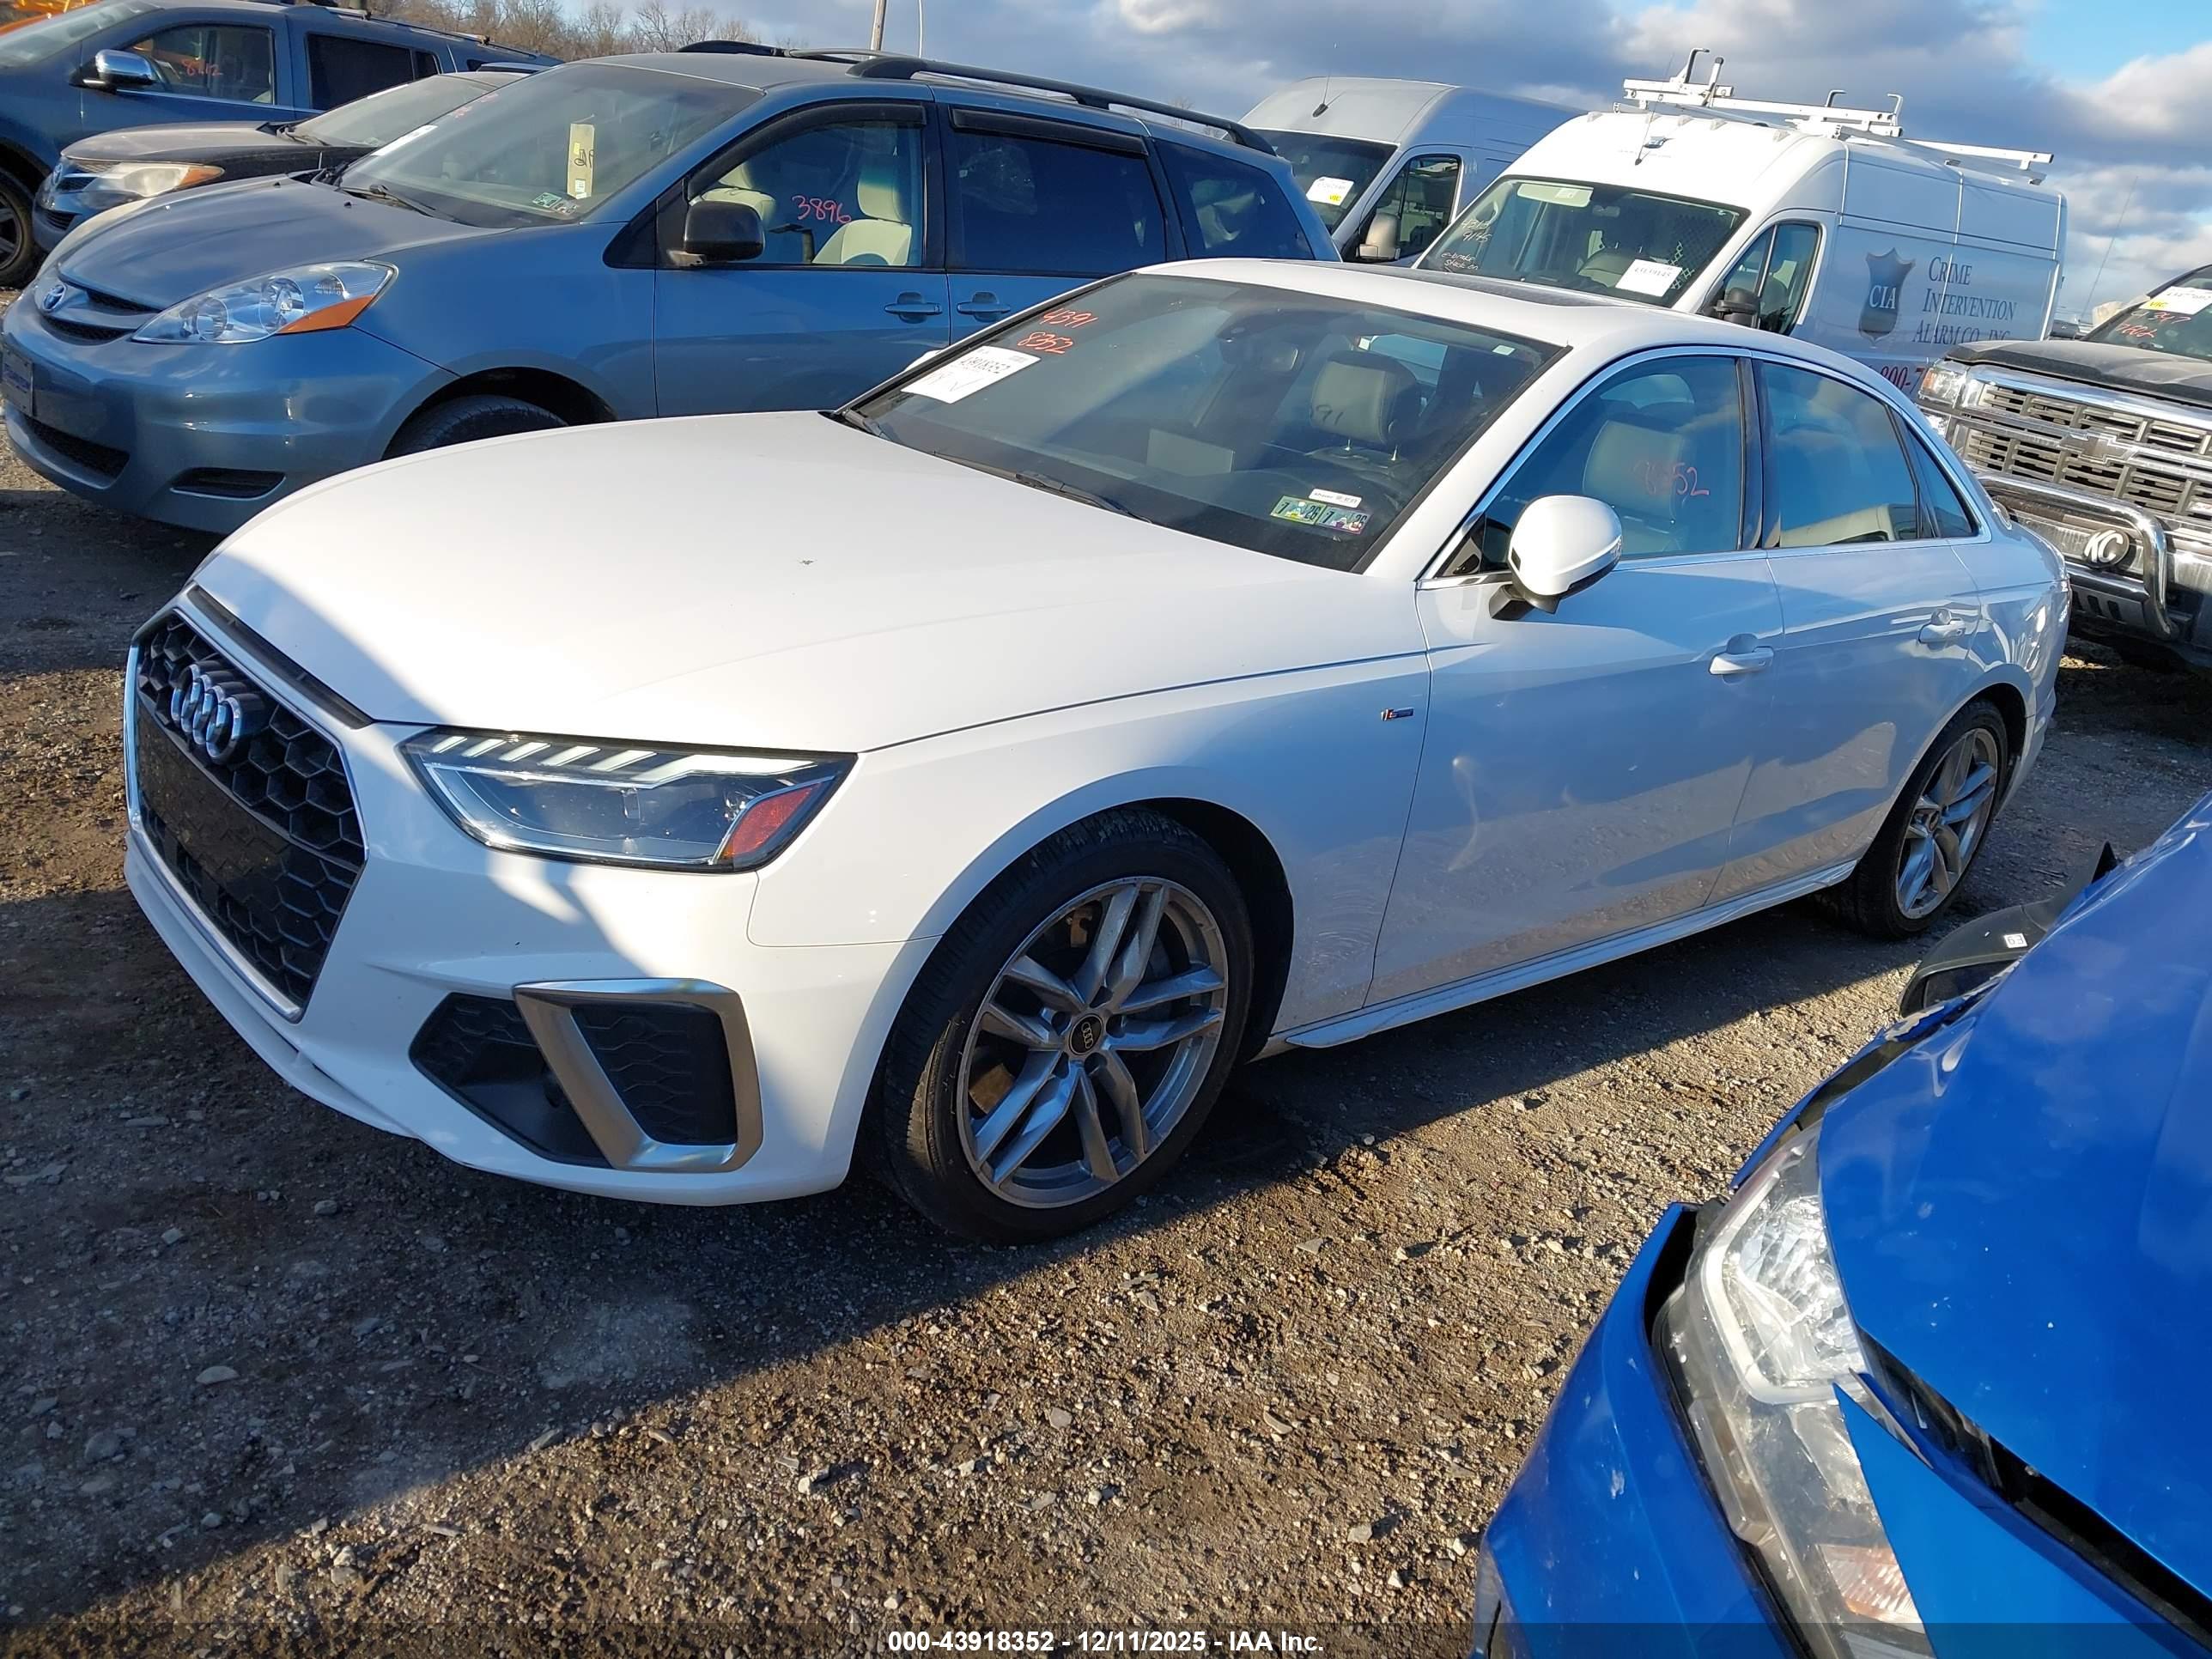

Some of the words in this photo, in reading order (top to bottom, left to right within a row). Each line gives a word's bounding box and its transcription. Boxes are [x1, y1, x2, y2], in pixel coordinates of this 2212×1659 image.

[792, 195, 852, 223] 3896
[1928, 257, 1972, 285] CRIME
[1869, 285, 1897, 310] CIA
[1922, 289, 2018, 321] INTERVENTION
[1040, 307, 1098, 329] 4391
[1017, 331, 1073, 355] 8352
[1912, 319, 1960, 344] ALARM
[2084, 530, 2124, 563] KC
